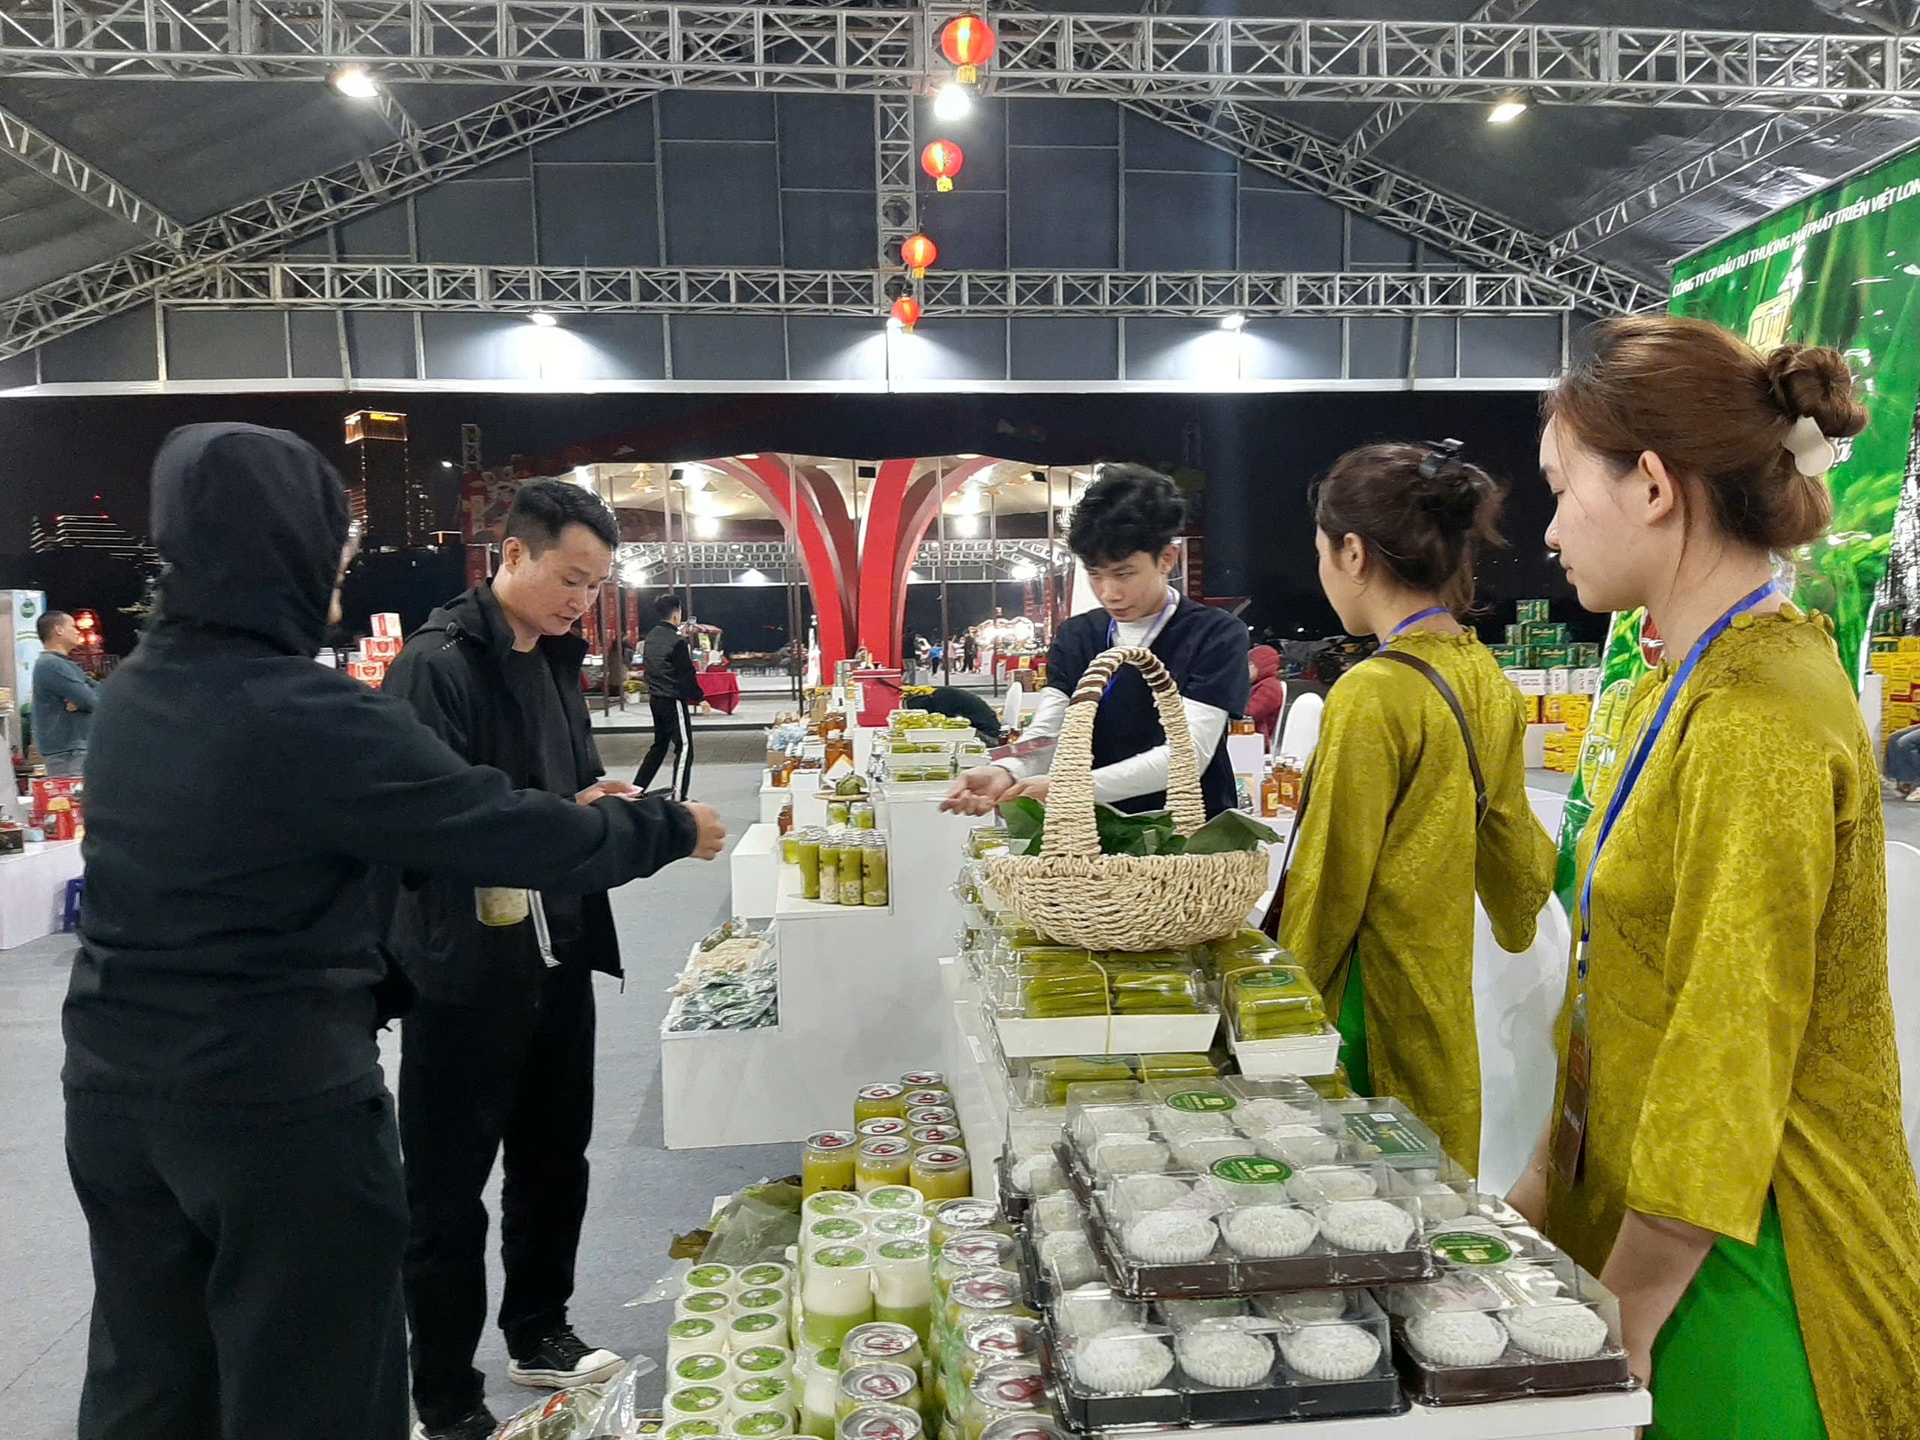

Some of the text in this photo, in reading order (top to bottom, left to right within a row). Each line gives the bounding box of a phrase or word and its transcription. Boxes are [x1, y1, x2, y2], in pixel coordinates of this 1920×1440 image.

[1672, 279, 1696, 298] CÔNG
[1695, 271, 1707, 288] TY
[1705, 267, 1718, 283] CP
[1735, 249, 1751, 270] TƯ
[1750, 234, 1791, 265] THƯƠNG
[1806, 211, 1838, 238] PHÁT
[1870, 187, 1898, 212] VIỆT
